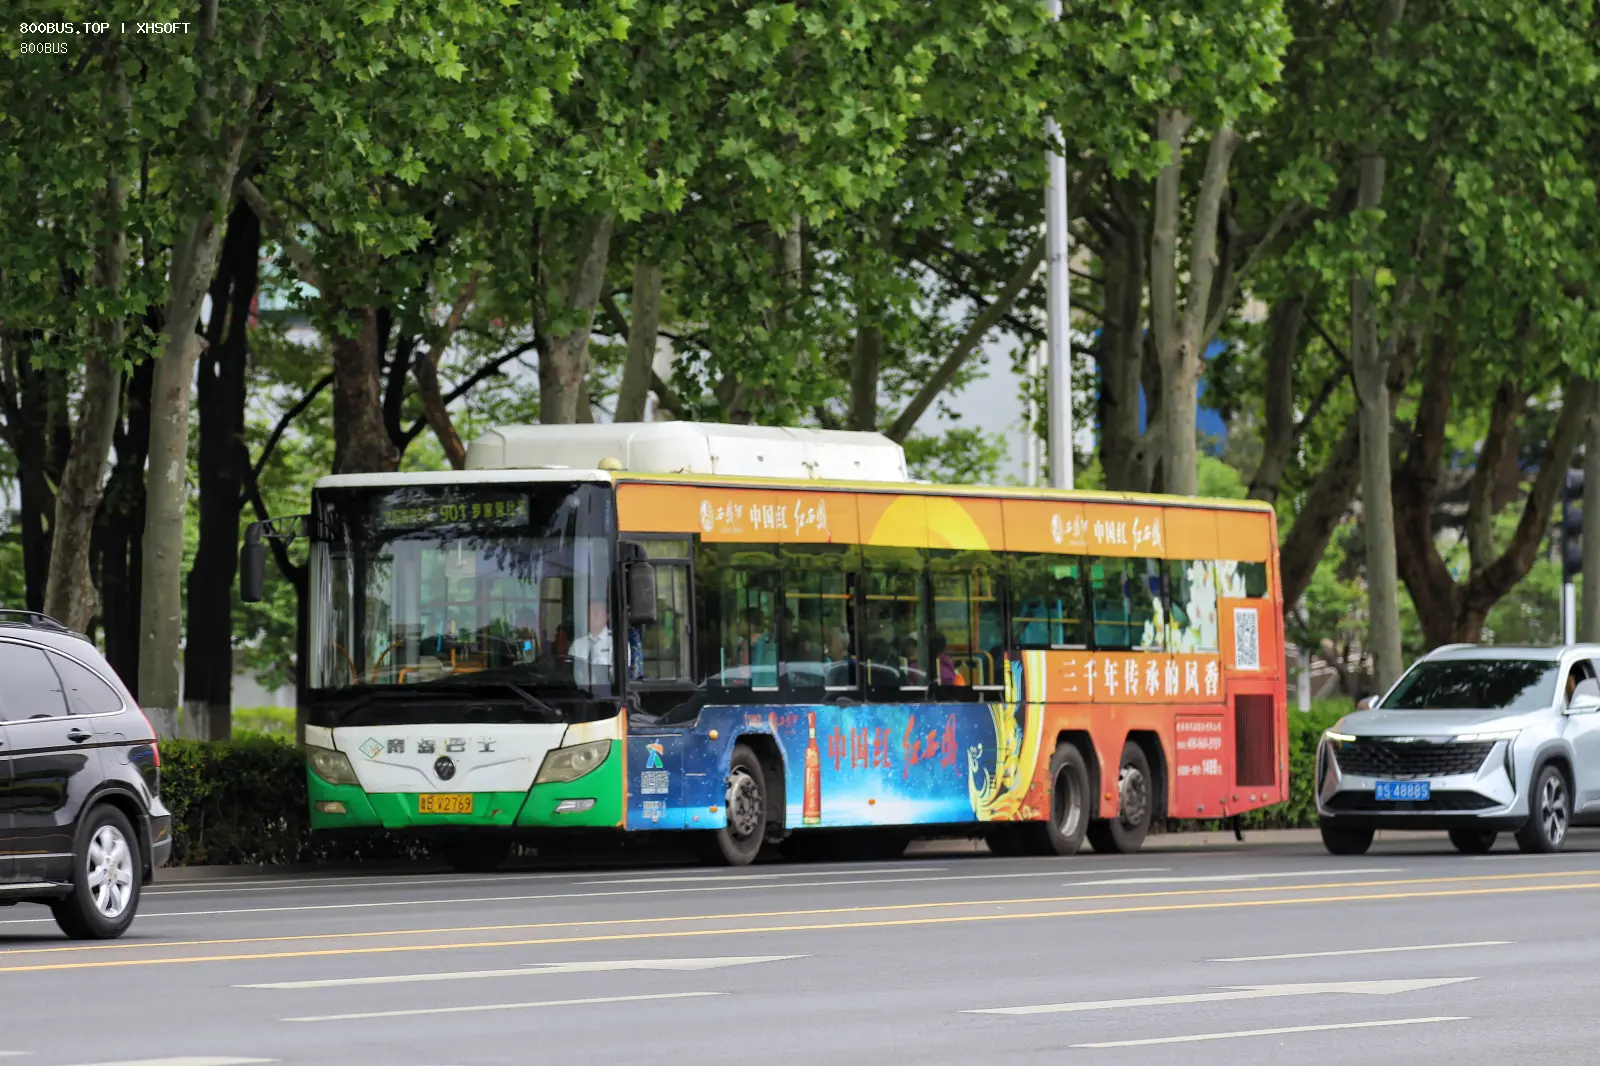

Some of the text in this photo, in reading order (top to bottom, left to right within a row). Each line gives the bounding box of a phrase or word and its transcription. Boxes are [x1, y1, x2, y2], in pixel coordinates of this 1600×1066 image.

[439, 504, 467, 522] 901
[750, 503, 788, 530] 中国红
[827, 726, 892, 772] 中国红
